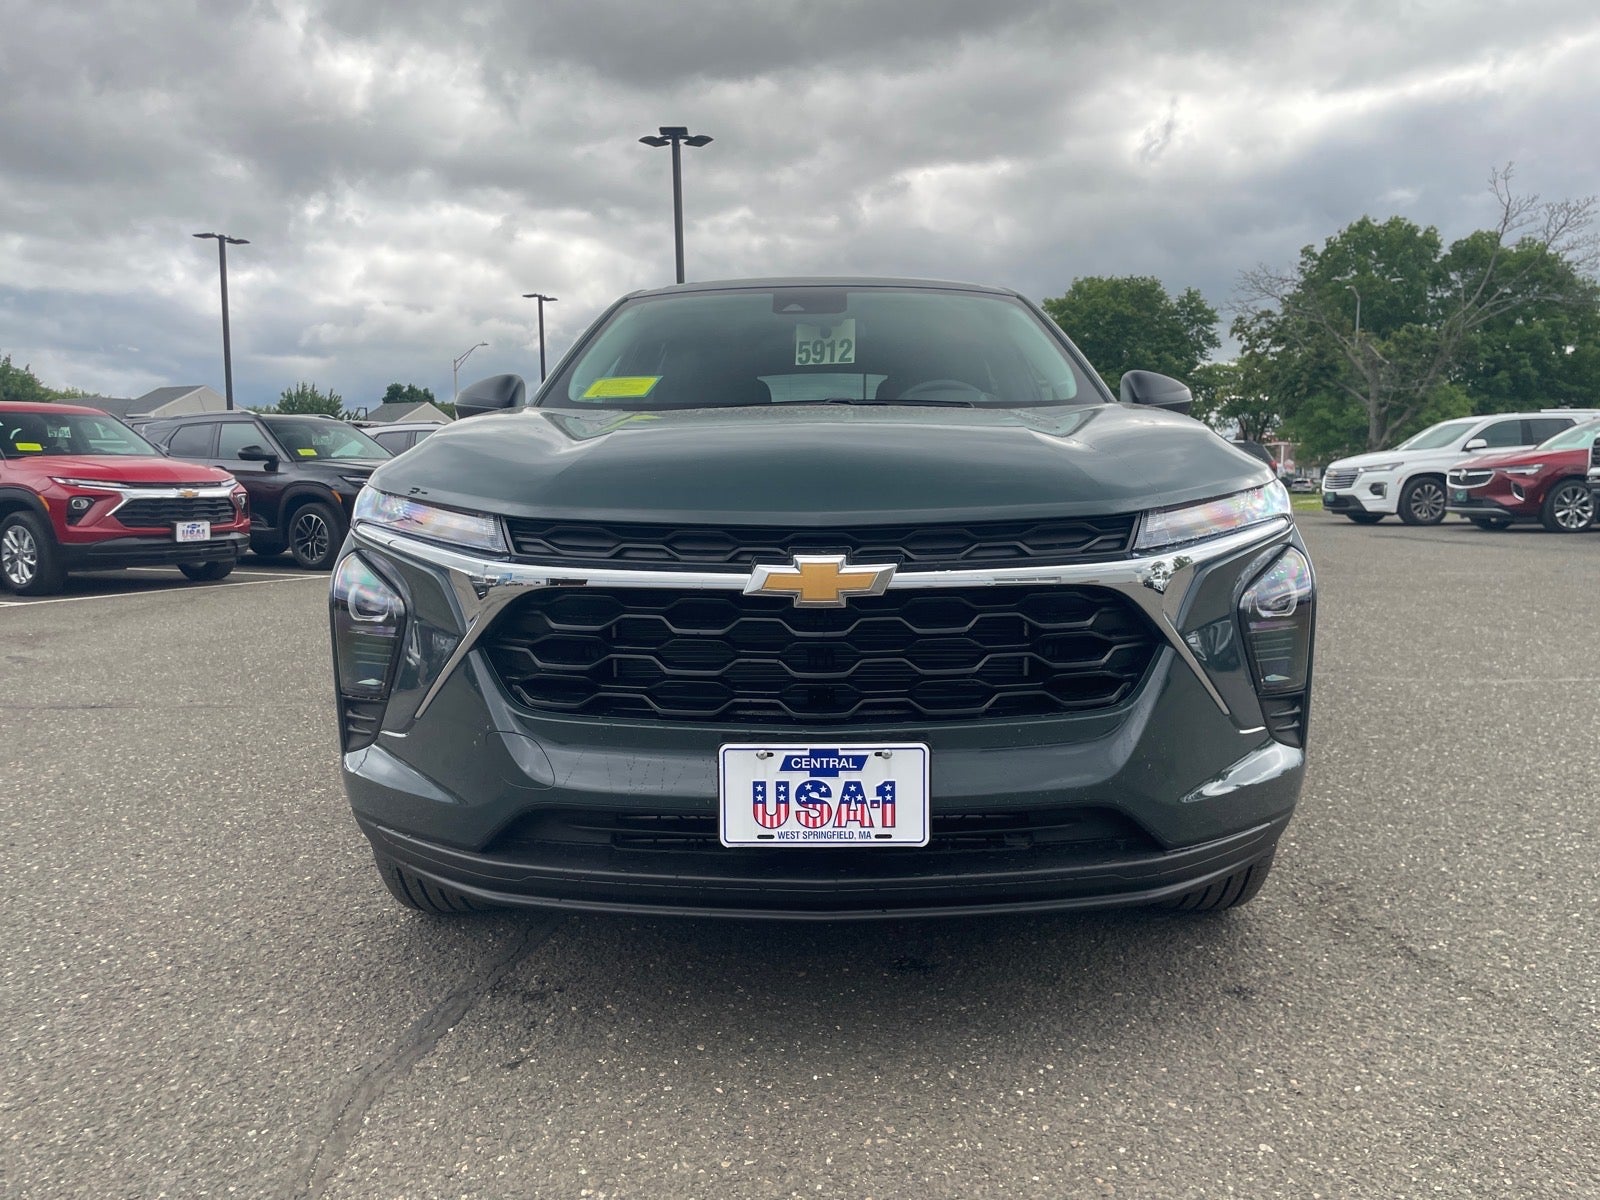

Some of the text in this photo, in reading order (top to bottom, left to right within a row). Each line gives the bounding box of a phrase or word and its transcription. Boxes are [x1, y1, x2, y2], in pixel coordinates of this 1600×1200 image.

[797, 338, 853, 365] 5912
[791, 757, 858, 769] CENTRAL
[777, 830, 872, 840] WEST SPRINGFIELD, MA
